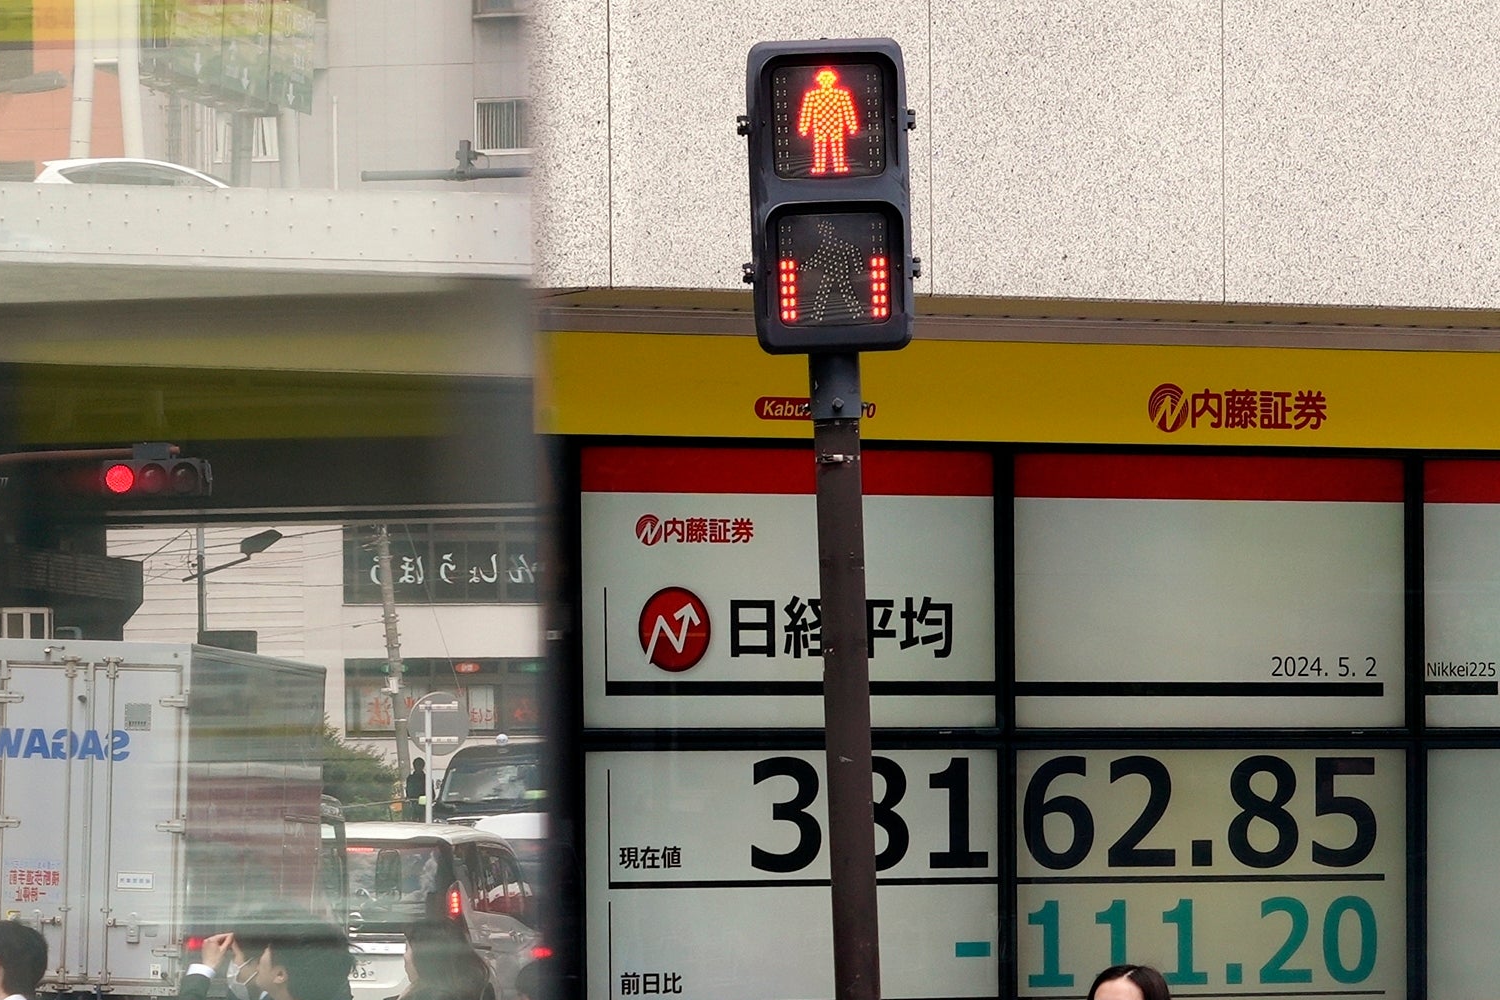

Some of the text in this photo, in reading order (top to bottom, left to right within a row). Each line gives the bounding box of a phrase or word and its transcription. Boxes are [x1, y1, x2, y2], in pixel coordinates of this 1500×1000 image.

[1191, 387, 1328, 431] 内藤証券
[663, 517, 754, 545] 内藤証券
[730, 595, 953, 659] 日経平均
[1426, 661, 1497, 678] Nikkei225
[618, 846, 682, 869] 現在値
[954, 895, 1378, 988] -111.20
[619, 972, 683, 995] 前日比
